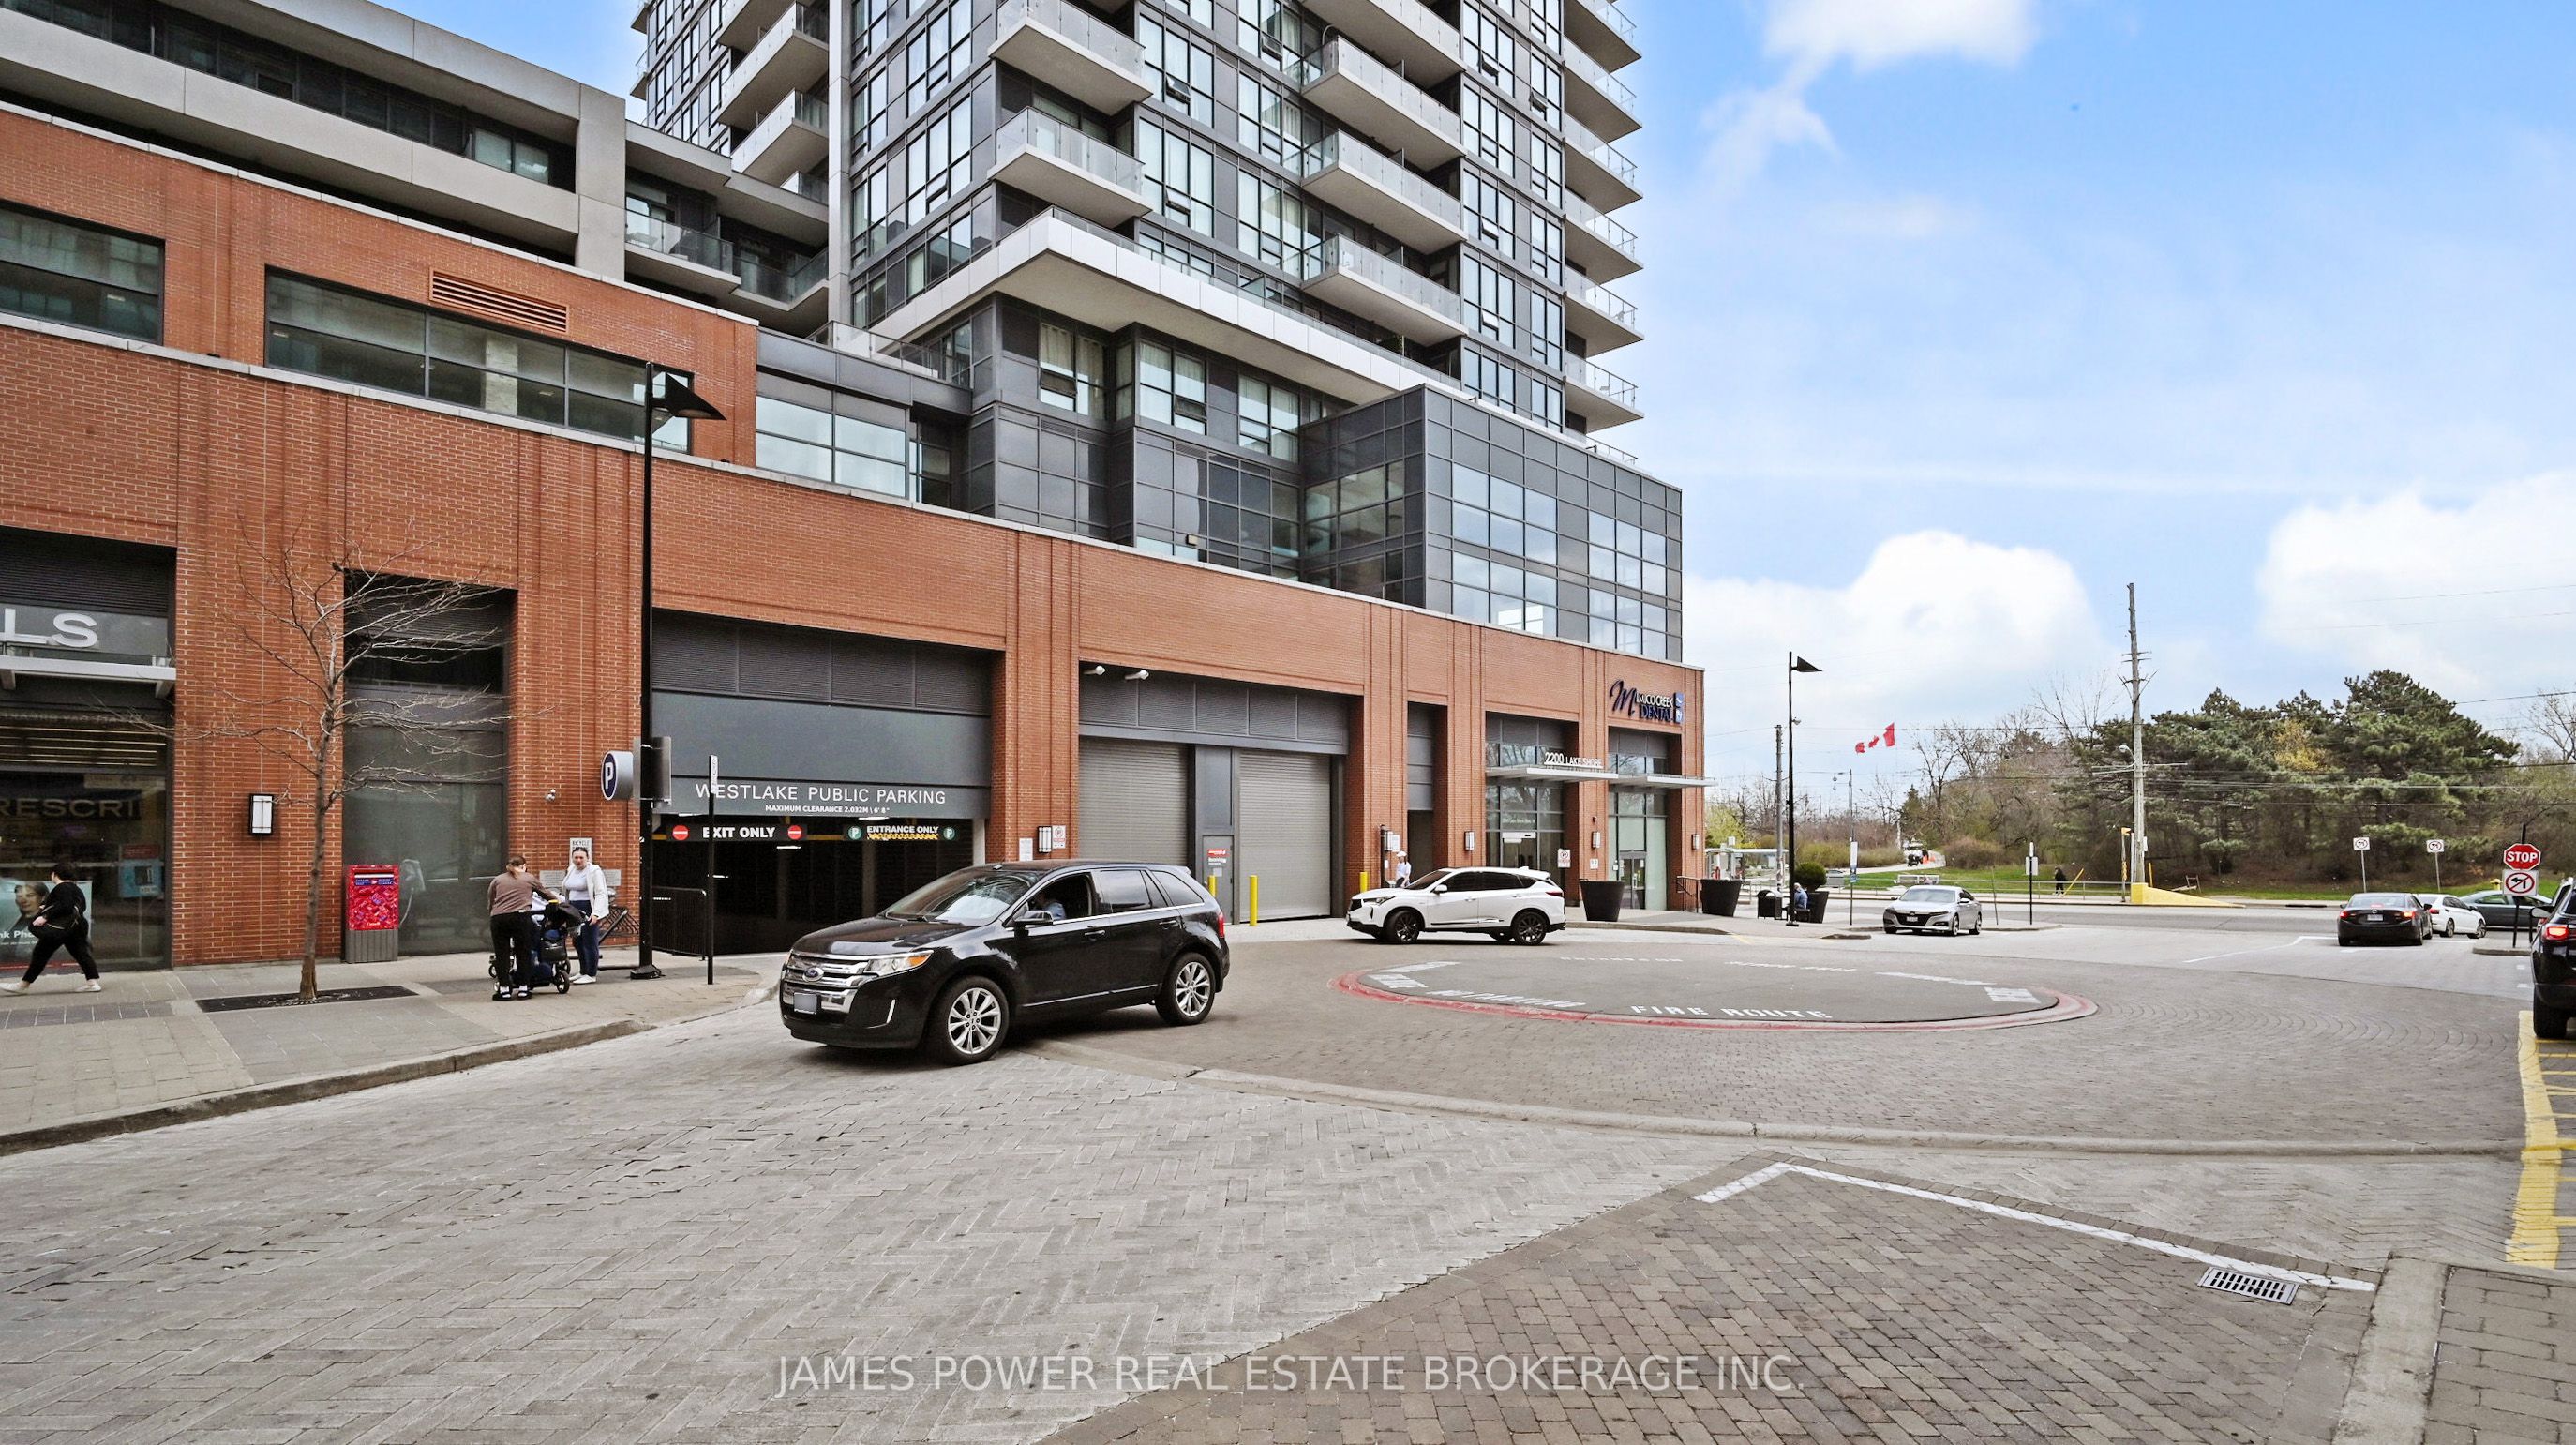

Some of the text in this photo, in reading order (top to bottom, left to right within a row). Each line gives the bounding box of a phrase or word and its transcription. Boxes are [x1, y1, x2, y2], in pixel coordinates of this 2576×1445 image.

[1544, 752, 1565, 765] 2200
[1565, 756, 1582, 766] LAKE
[604, 762, 614, 790] P
[695, 783, 946, 805] WESTLAKE PUBLIC PARKING
[765, 804, 801, 812] MAXIMUM
[702, 826, 775, 838] EXIT ONLY
[866, 825, 915, 834] ENTRANCE
[2507, 851, 2538, 863] STOP
[1630, 1005, 1833, 1018] FIRE ROUTE
